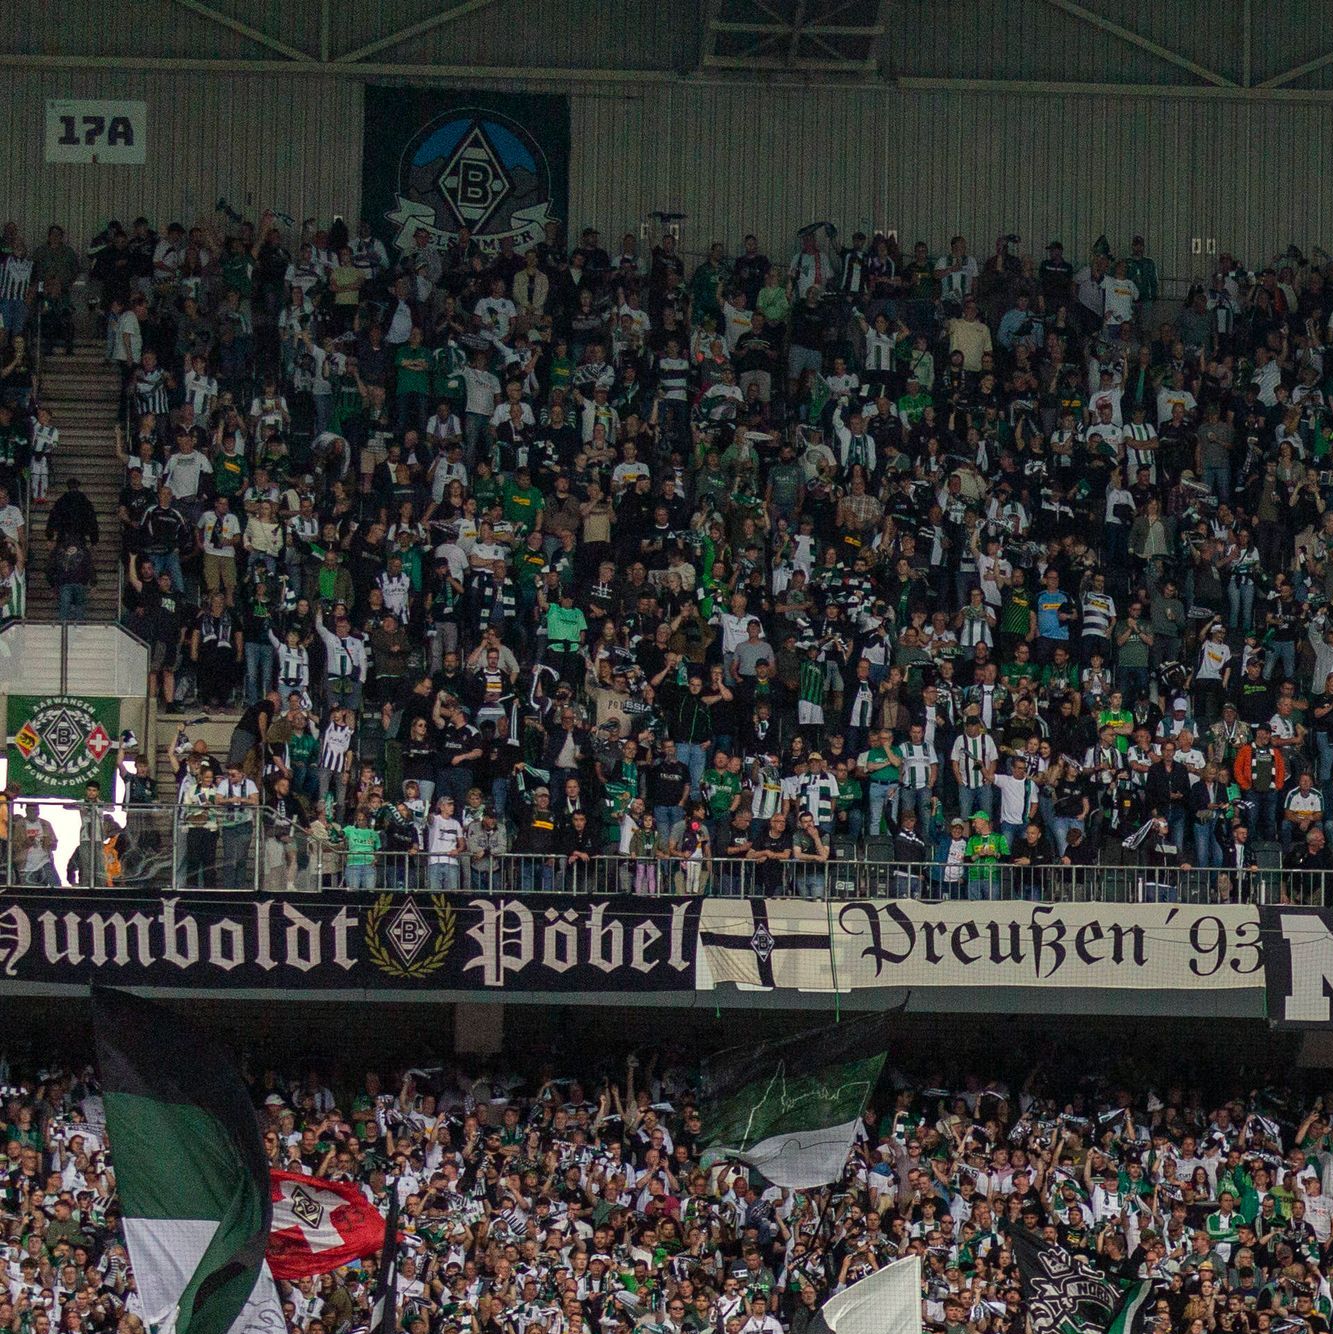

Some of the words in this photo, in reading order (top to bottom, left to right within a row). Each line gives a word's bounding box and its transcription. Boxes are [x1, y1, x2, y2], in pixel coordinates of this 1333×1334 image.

[58, 115, 135, 147] 17A
[461, 898, 691, 988] Pöbel
[838, 901, 1152, 980] Preußen
